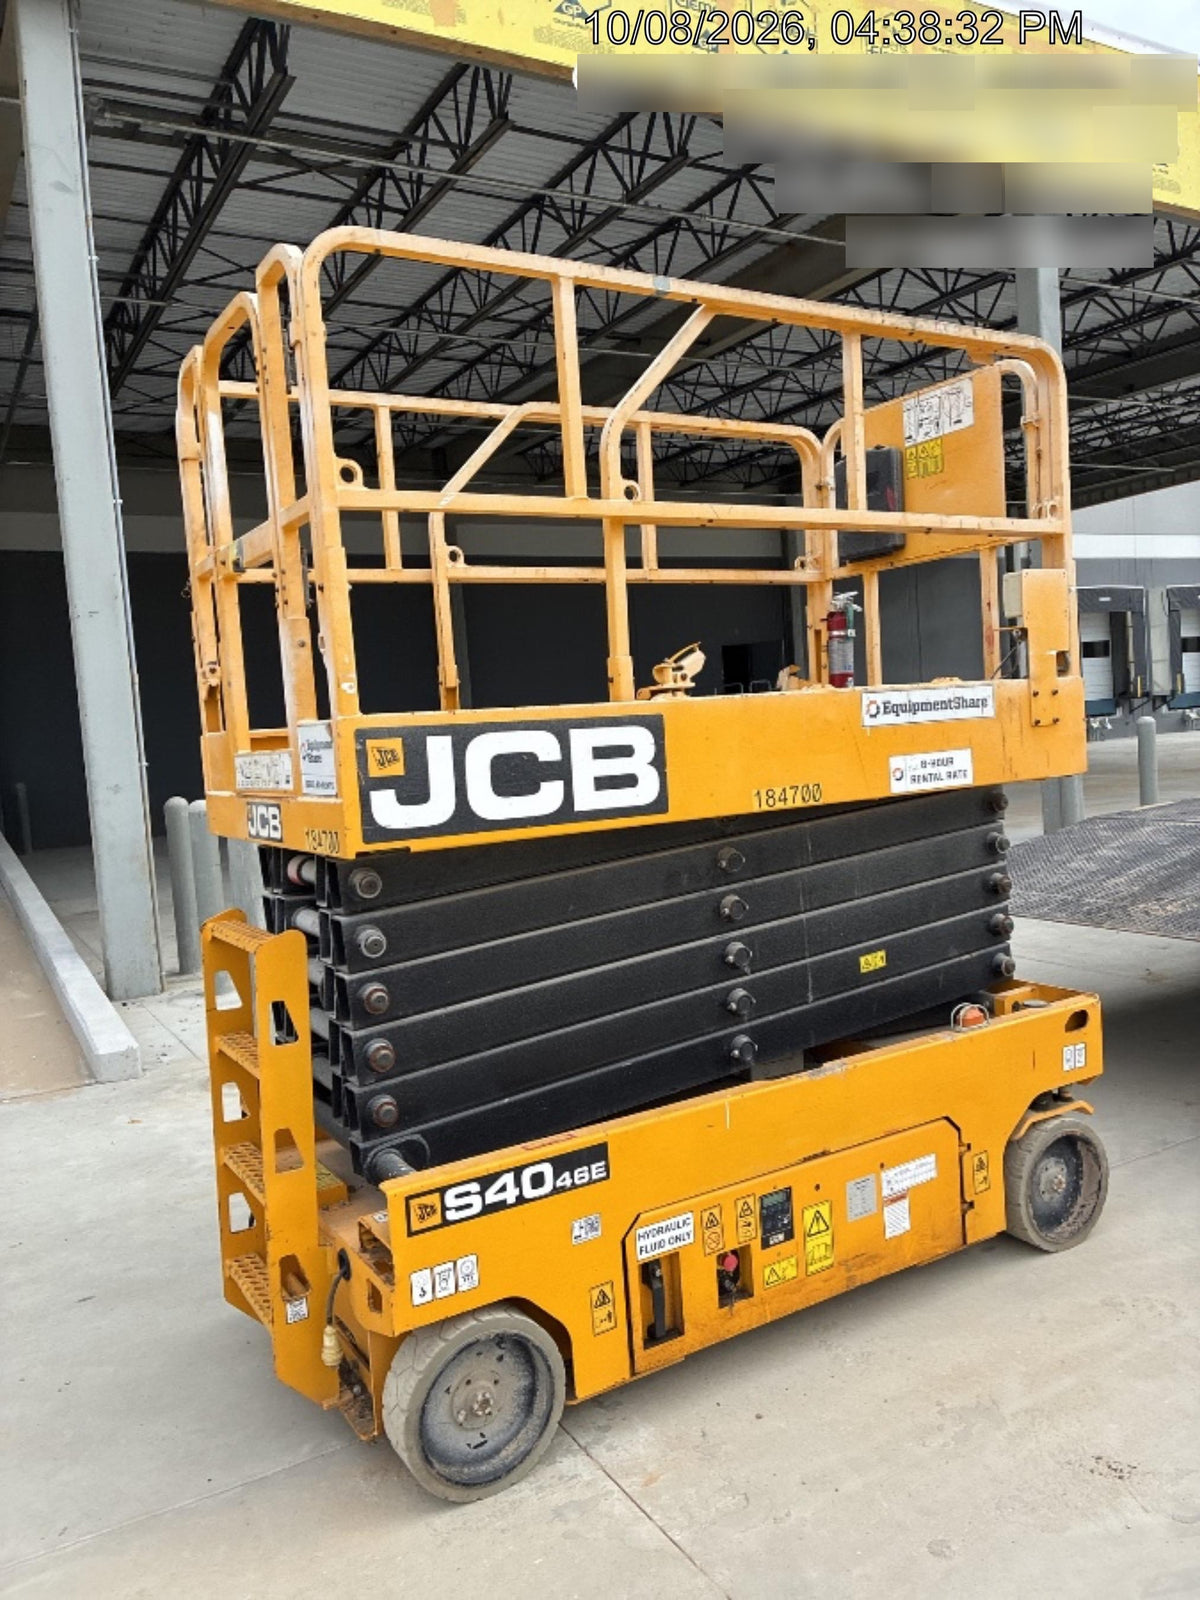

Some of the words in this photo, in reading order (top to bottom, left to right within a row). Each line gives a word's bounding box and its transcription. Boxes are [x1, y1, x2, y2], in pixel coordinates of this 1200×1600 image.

[370, 725, 661, 830] JCB
[910, 773, 945, 784] RENTAL
[754, 783, 822, 808] 184700
[248, 804, 281, 839] JCB
[637, 1217, 691, 1241] HYDRAULIC
[639, 1239, 666, 1256] FLUID
[668, 1230, 692, 1246] ONLY
